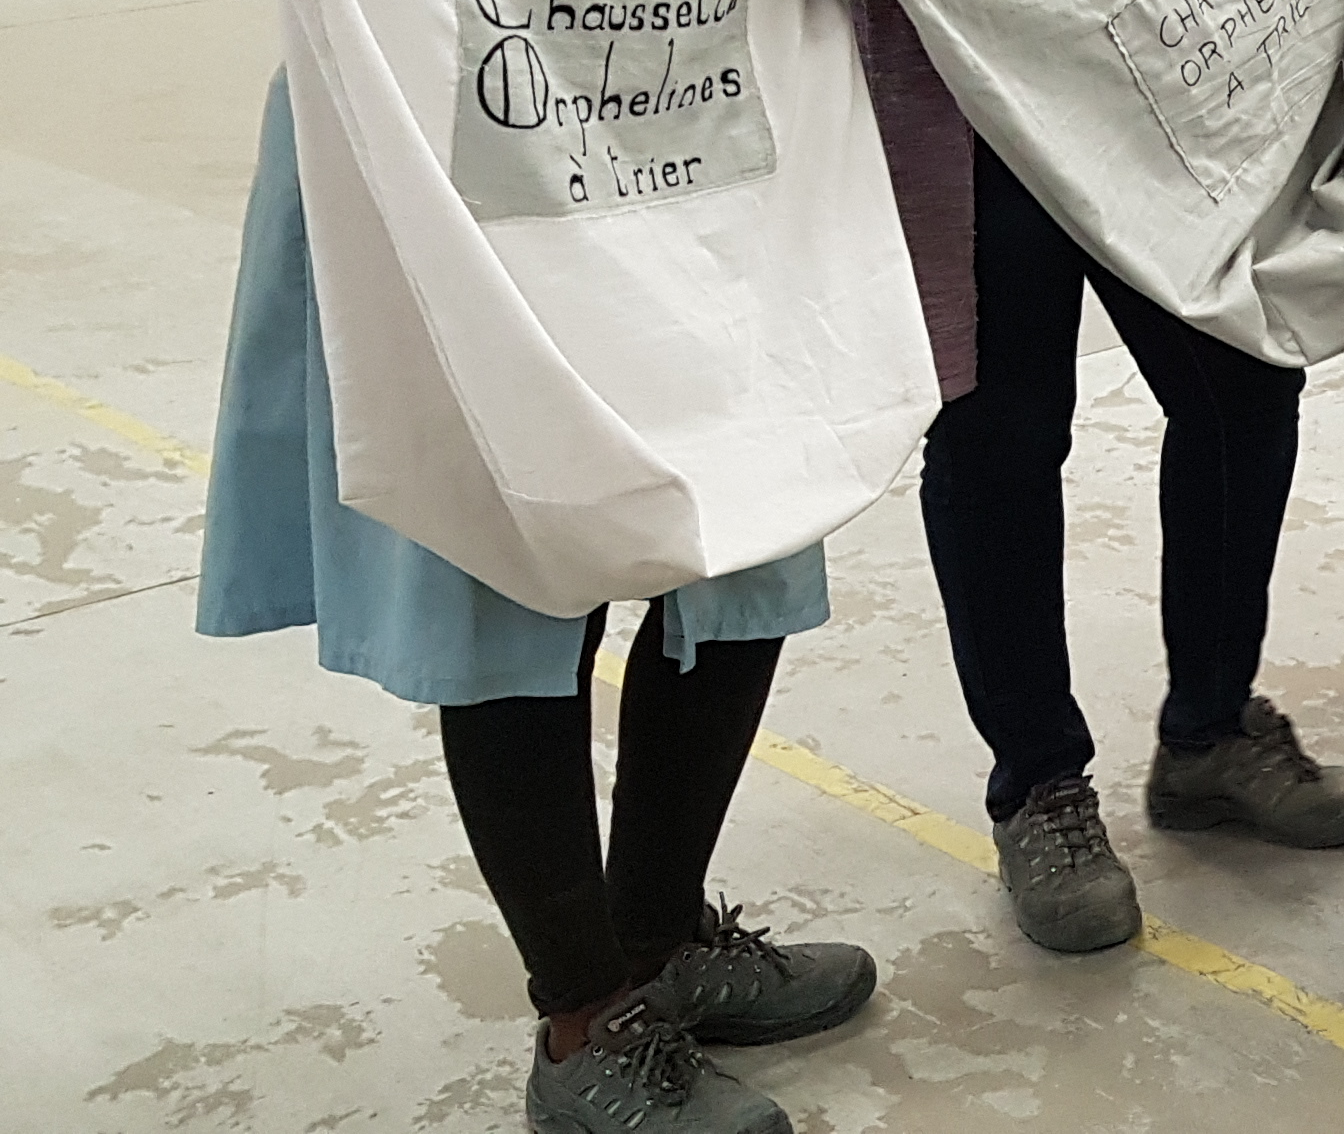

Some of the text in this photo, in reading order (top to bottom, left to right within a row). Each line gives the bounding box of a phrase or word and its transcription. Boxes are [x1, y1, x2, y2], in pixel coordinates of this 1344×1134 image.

[477, 35, 742, 156] Orphelines
[1227, 71, 1245, 108] A
[568, 146, 702, 203] à trier
